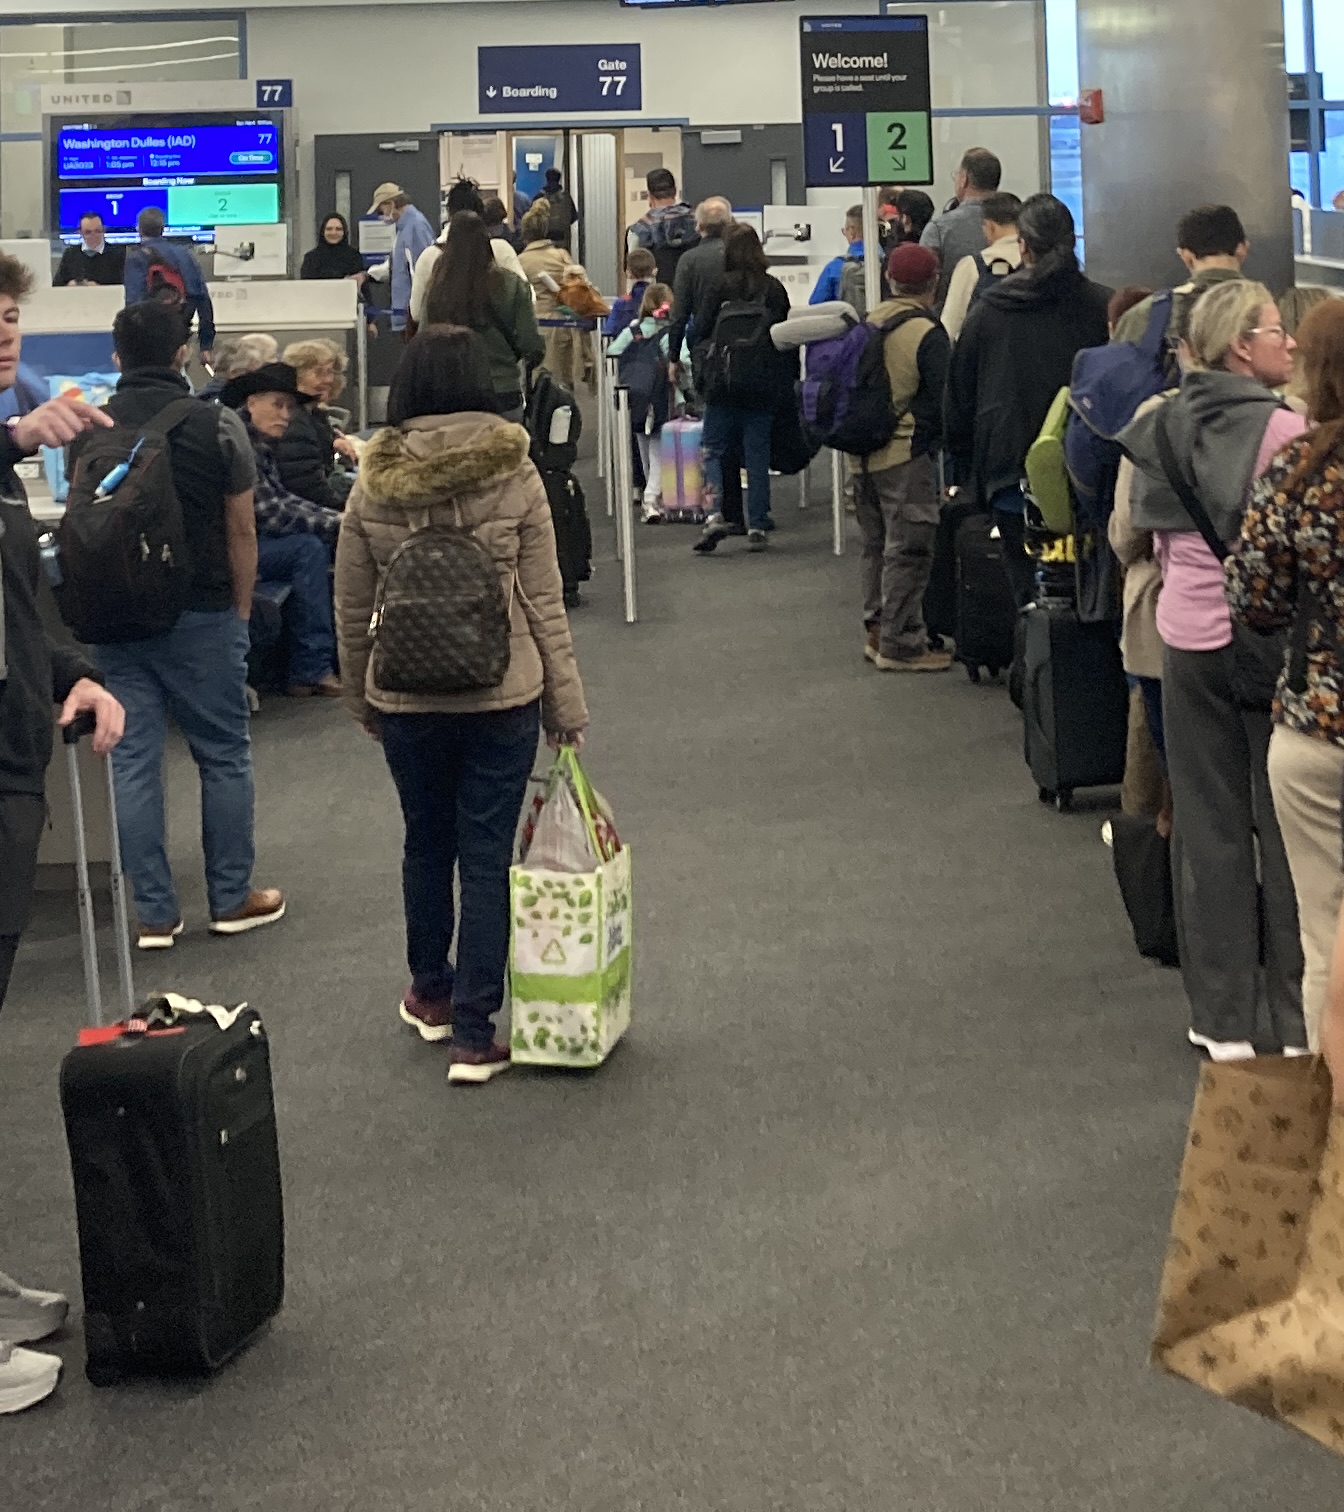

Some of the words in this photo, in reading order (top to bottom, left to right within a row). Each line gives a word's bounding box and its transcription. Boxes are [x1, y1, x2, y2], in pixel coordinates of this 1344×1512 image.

[597, 58, 627, 71] Gate
[812, 52, 889, 69] Welcome!
[261, 85, 283, 102] 77
[502, 85, 557, 99] Boarding
[599, 75, 627, 96] 77
[51, 94, 112, 105] UNITED
[63, 138, 130, 151] Washington
[131, 136, 166, 148] Dulles
[167, 134, 196, 149] (IAD)
[258, 133, 273, 145] 77
[831, 123, 844, 152] 1
[886, 122, 907, 151] 2
[143, 177, 176, 186] Boarding
[176, 177, 194, 185] Now
[111, 200, 118, 216] 1
[218, 198, 228, 212] 2
